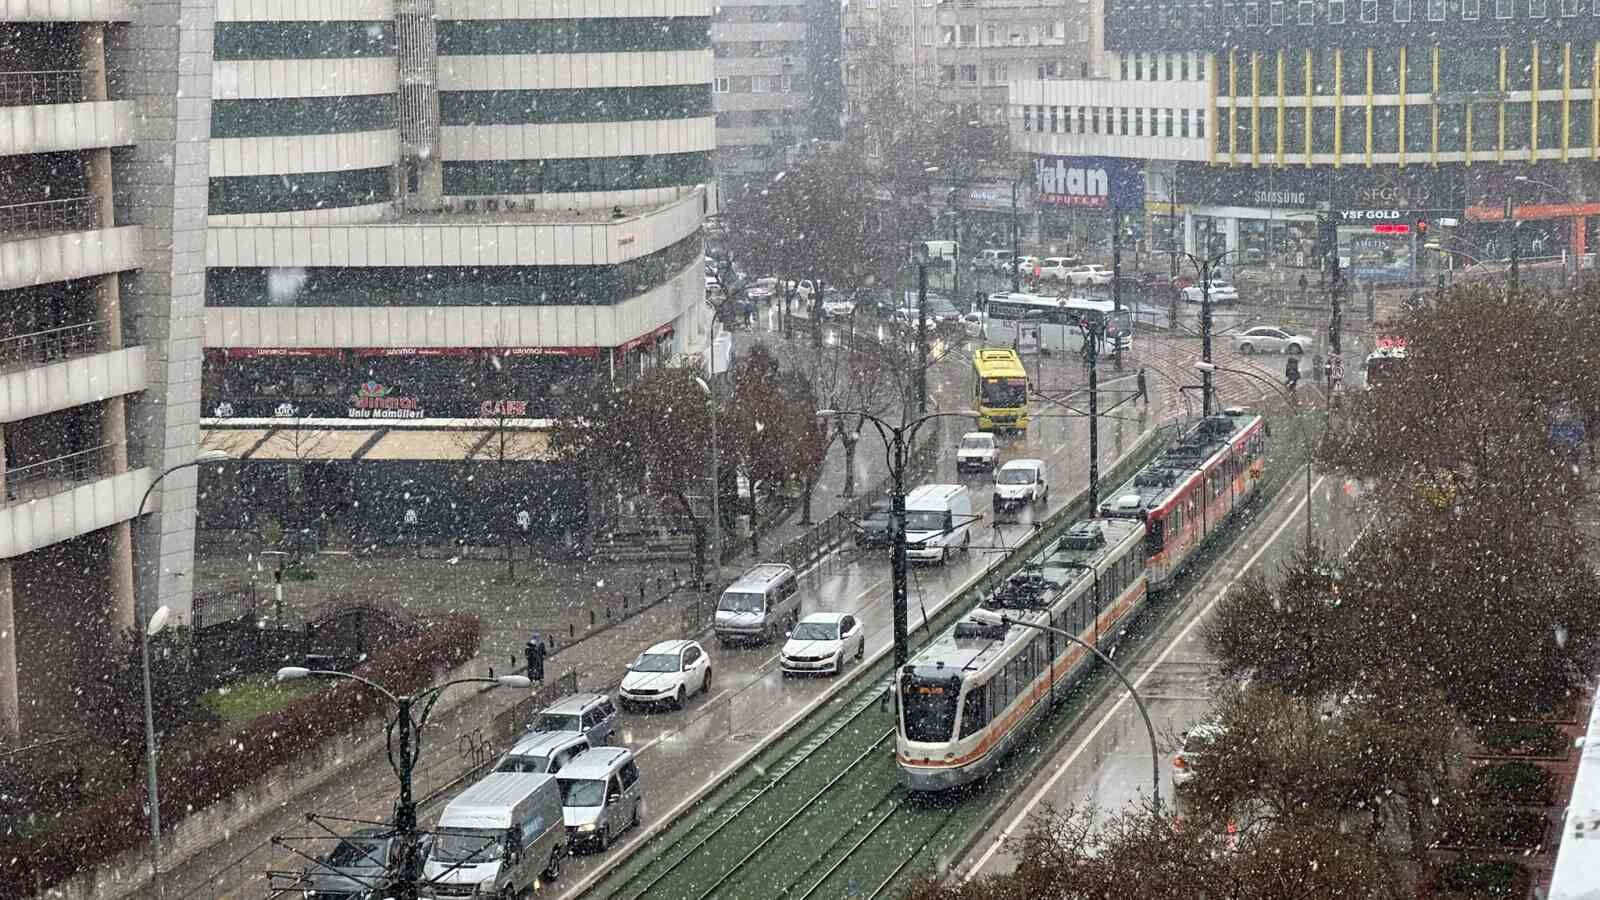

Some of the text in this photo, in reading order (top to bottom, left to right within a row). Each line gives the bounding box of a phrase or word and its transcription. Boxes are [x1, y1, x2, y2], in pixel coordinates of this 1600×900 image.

[1254, 191, 1305, 204] SAMSUNG
[1341, 209, 1400, 219] YSF GOLD
